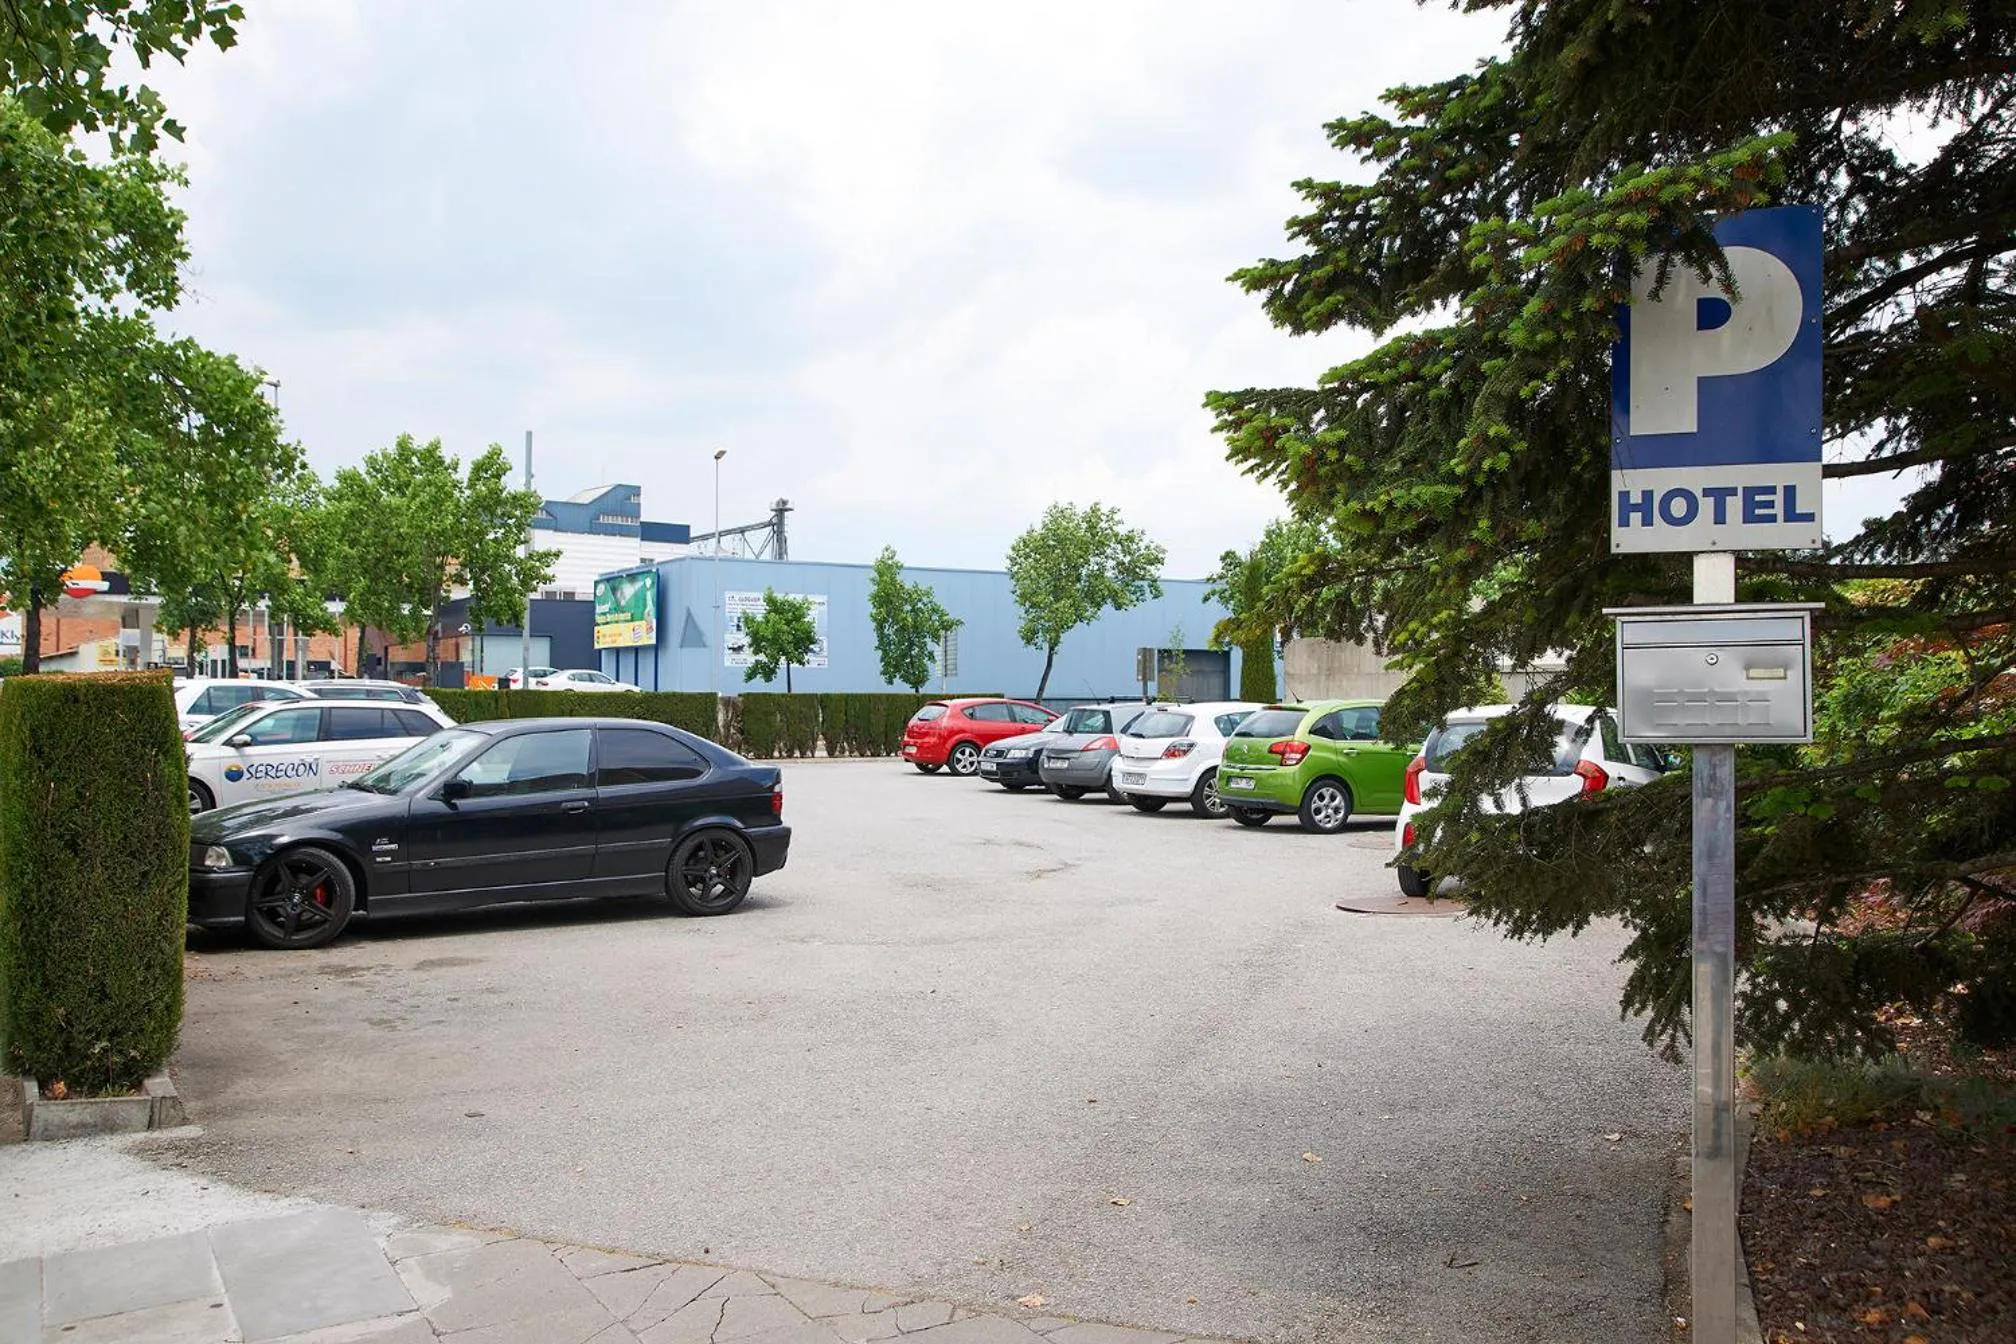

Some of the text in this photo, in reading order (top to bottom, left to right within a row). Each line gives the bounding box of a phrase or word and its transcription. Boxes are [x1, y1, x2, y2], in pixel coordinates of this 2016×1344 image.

[1629, 245, 1803, 437] P
[1617, 484, 1816, 529] HOTEL
[246, 762, 319, 780] SERECON
